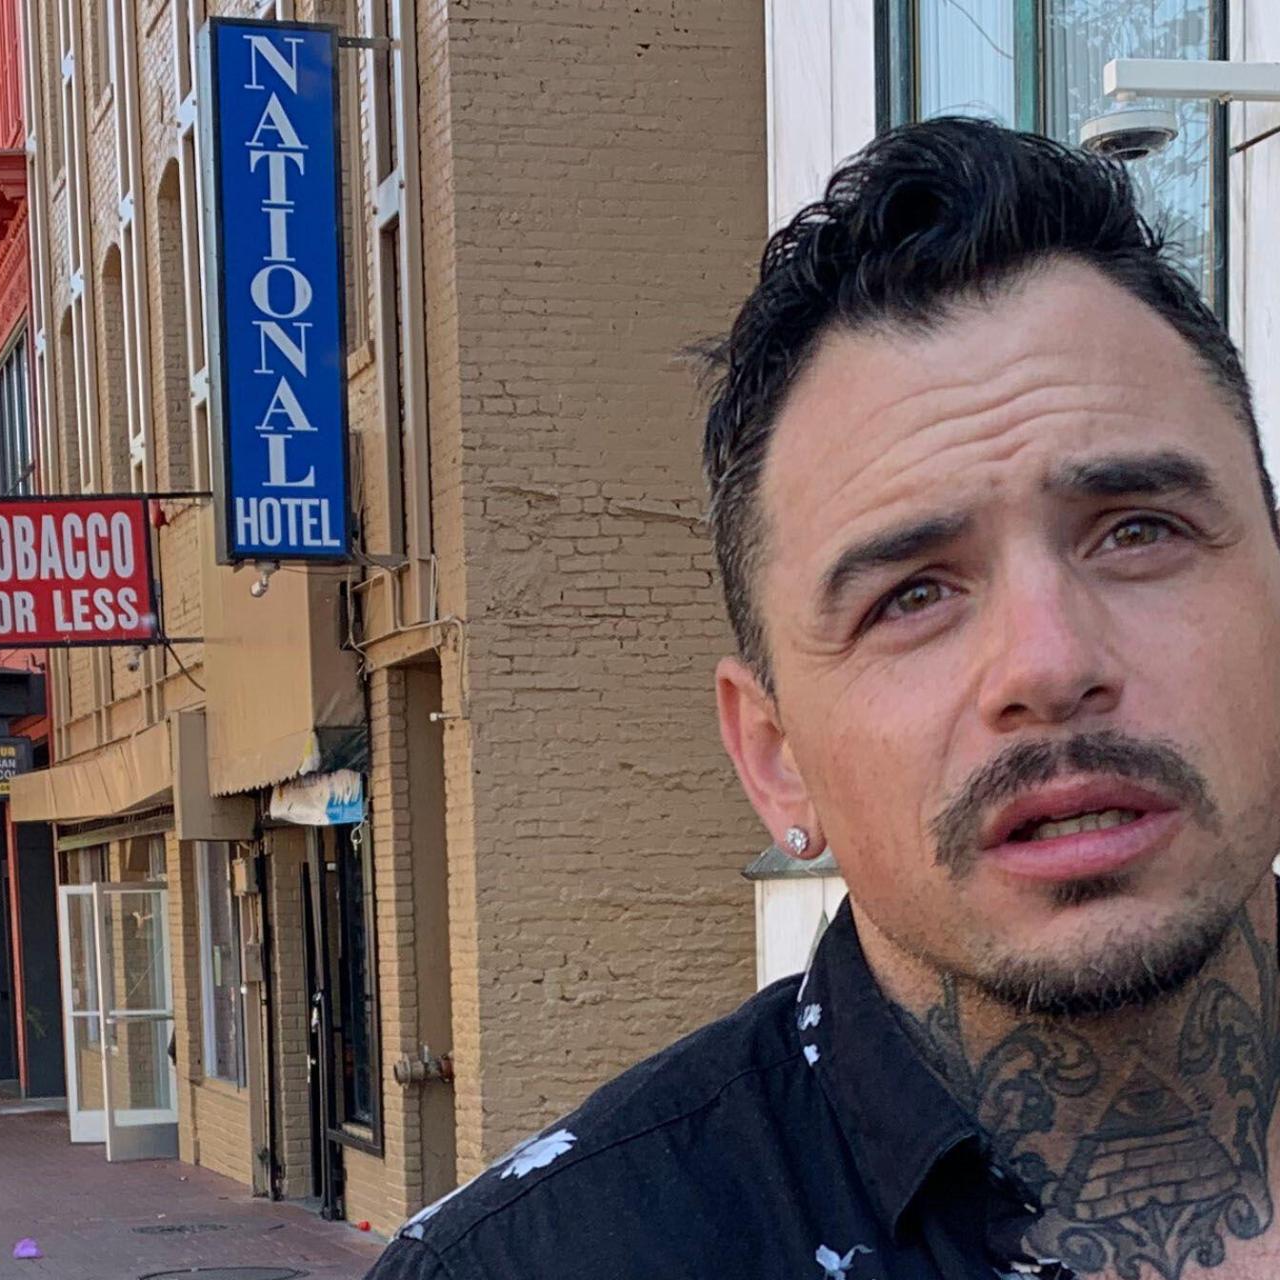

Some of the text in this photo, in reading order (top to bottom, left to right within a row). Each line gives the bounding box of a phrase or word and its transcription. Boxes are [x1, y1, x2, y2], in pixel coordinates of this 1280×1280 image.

[243, 35, 318, 488] NATIONAL
[235, 497, 341, 547] HOTEL
[52, 587, 139, 633] LESS
